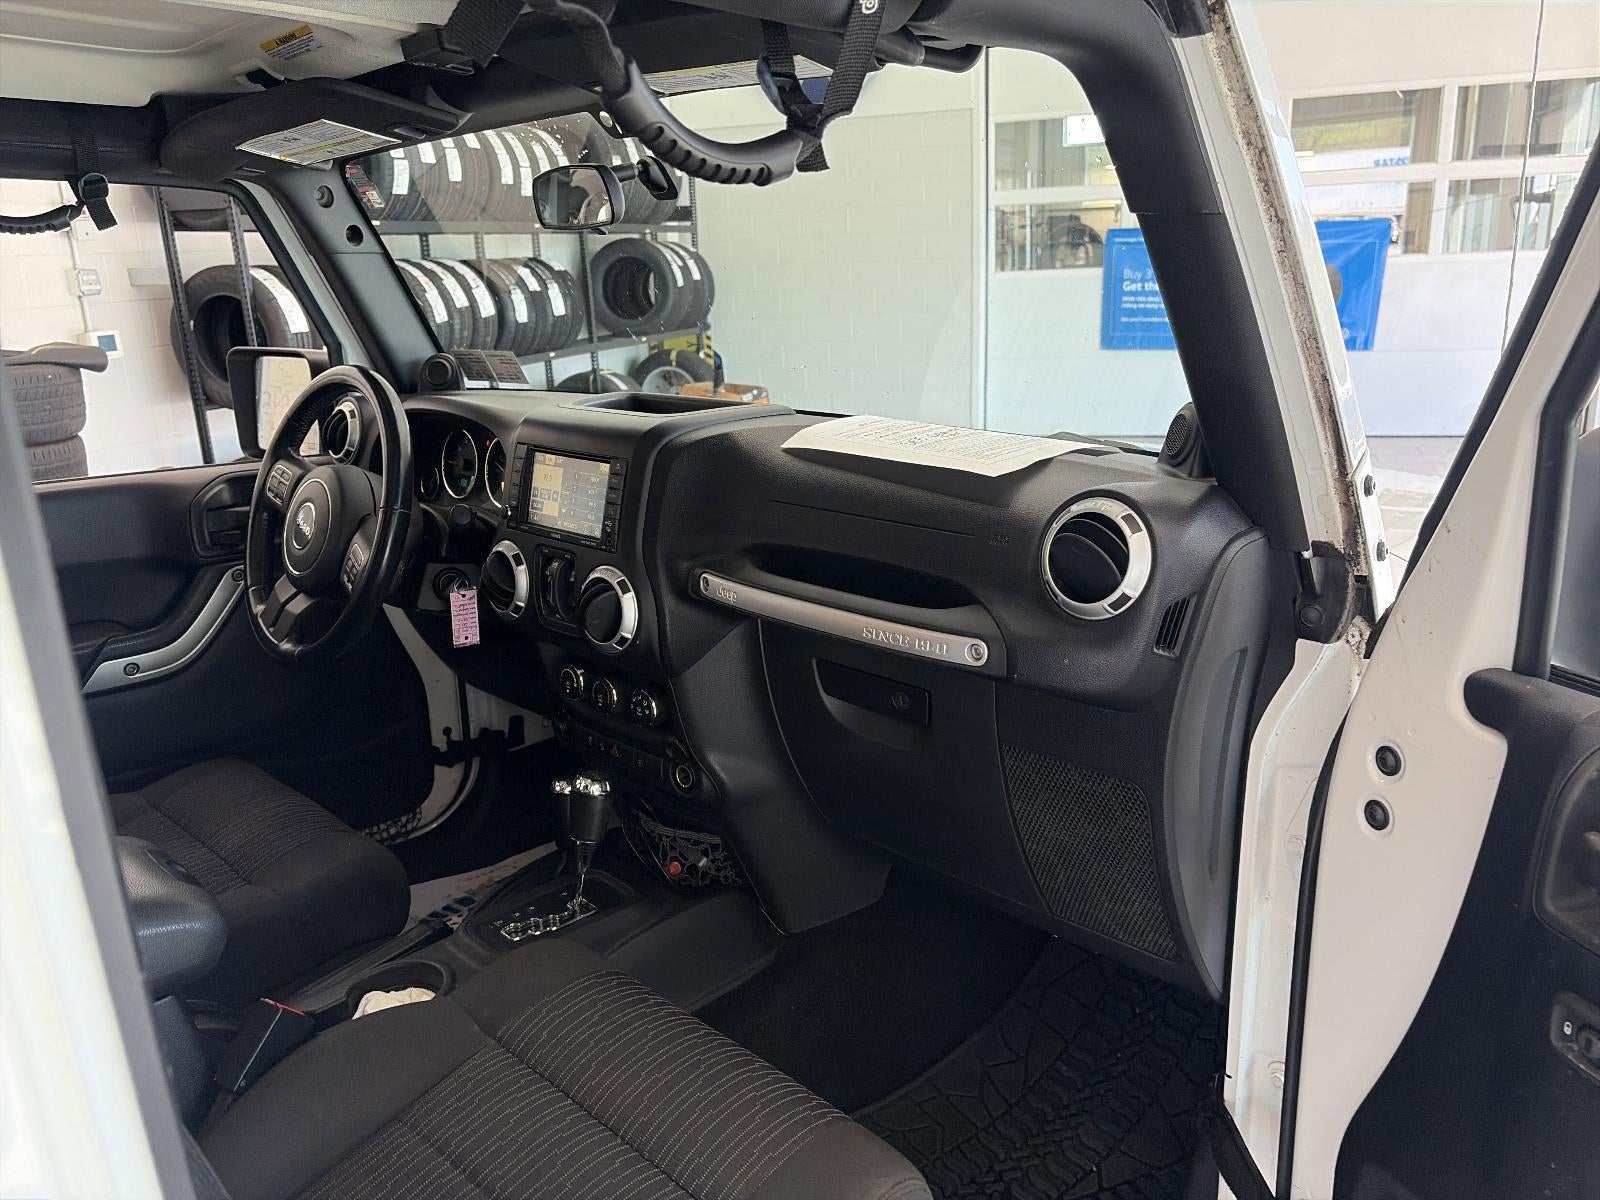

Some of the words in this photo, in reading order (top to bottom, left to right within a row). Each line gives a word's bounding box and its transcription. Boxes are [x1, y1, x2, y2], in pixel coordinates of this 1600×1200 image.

[1123, 268, 1143, 281] Buy
[1122, 280, 1142, 291] Get
[716, 584, 737, 604] Jeep
[863, 626, 910, 648] SINCE
[915, 638, 948, 655] 1941
